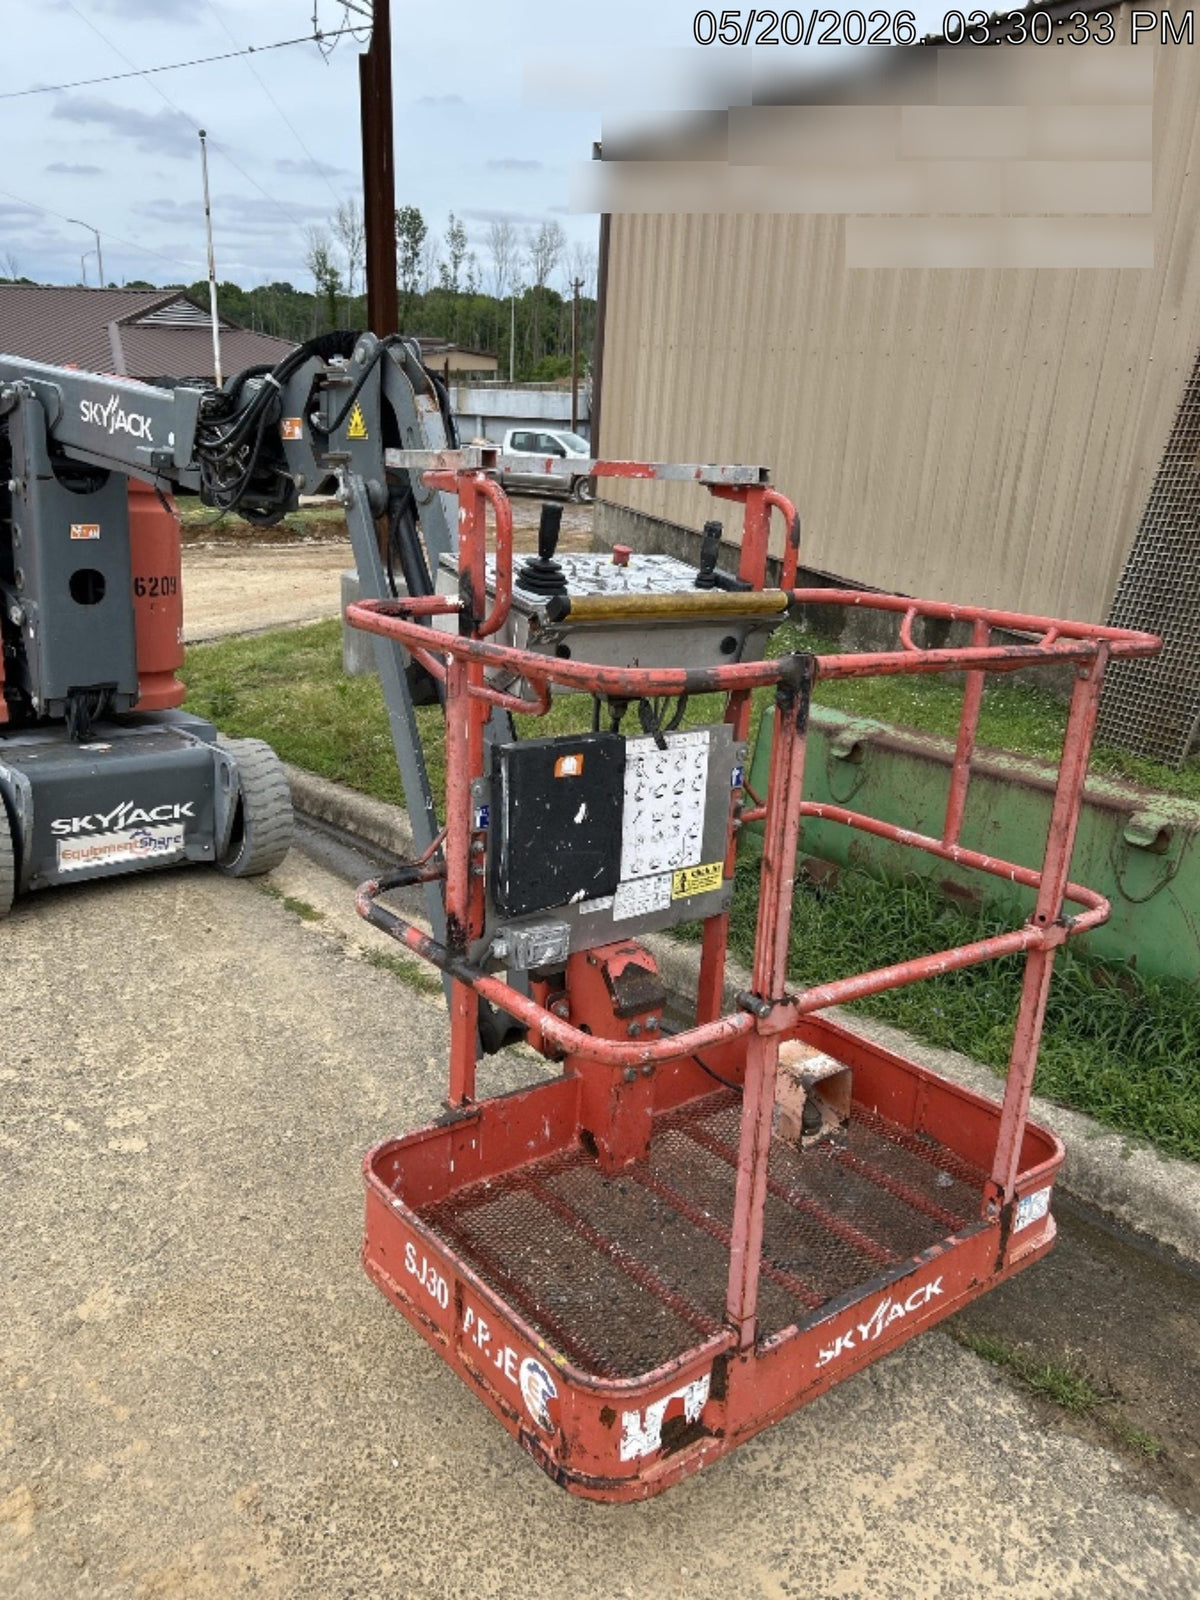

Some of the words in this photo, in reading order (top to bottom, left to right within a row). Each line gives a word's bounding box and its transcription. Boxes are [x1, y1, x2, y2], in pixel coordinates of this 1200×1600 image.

[79, 394, 153, 442] SKYJACK
[134, 575, 177, 597] 6209
[50, 800, 196, 835] SKYJACK
[404, 1242, 449, 1310] SJ30
[815, 1275, 944, 1368] SKYJACK
